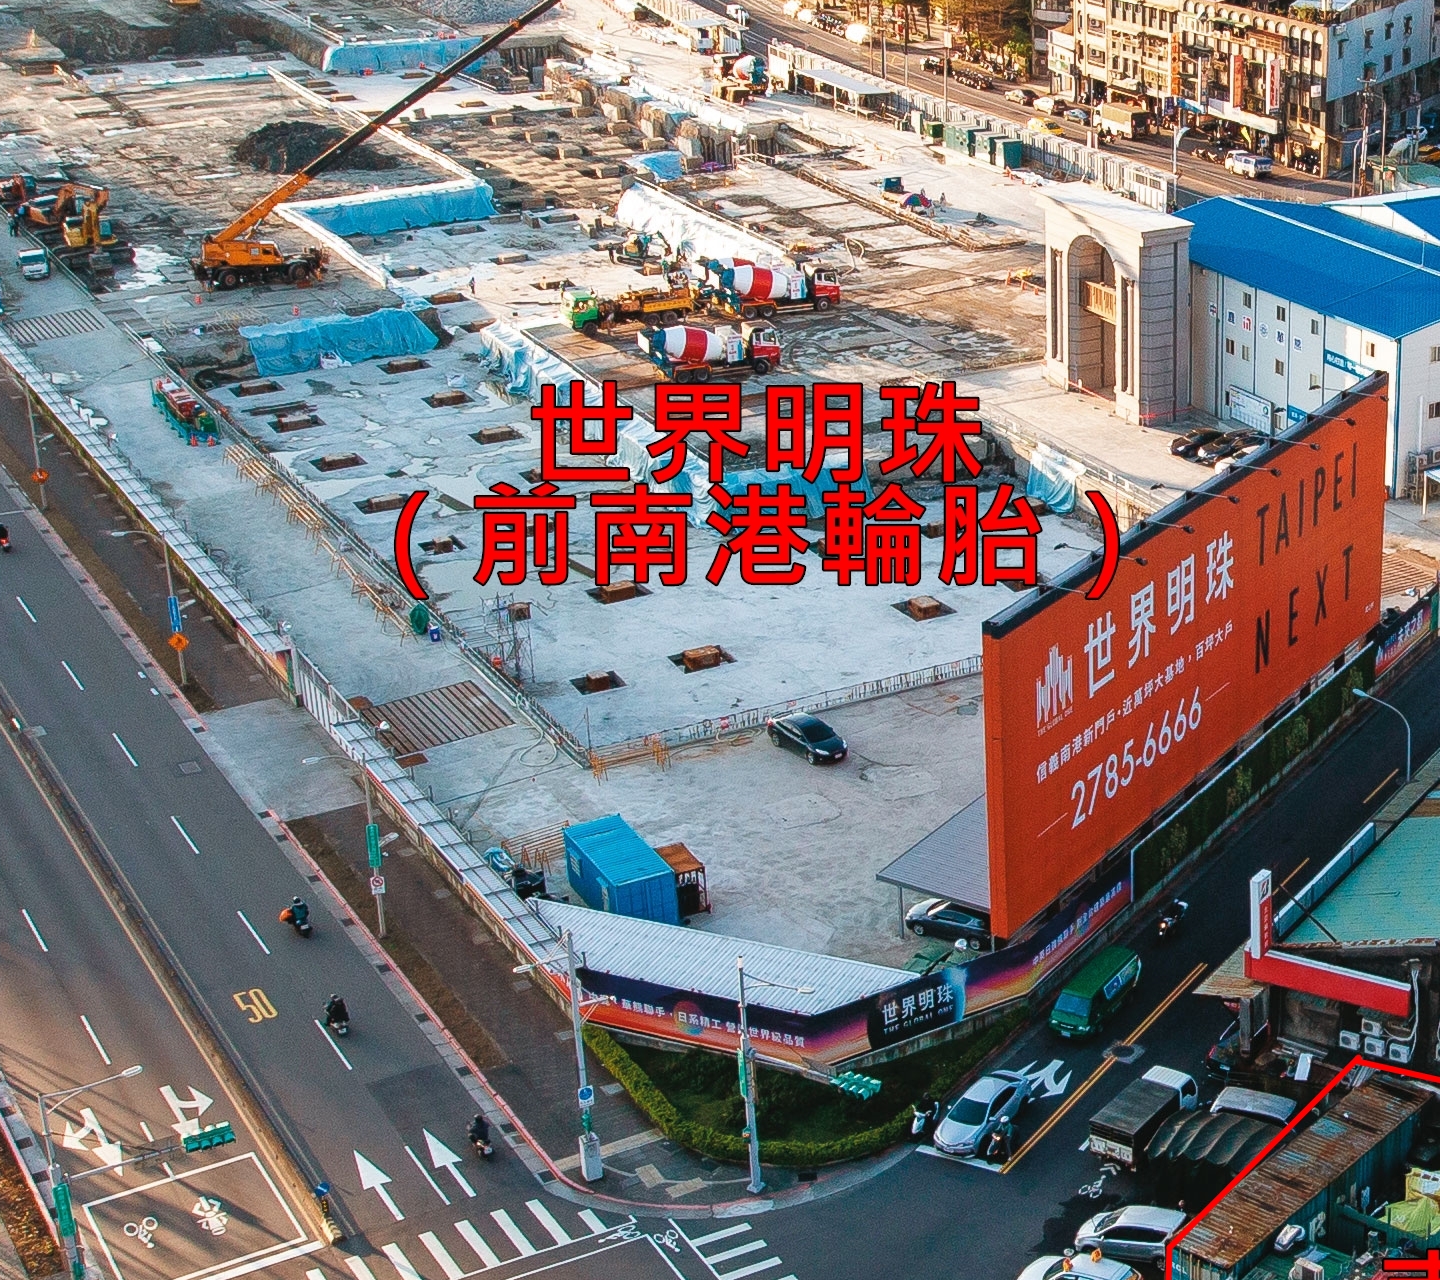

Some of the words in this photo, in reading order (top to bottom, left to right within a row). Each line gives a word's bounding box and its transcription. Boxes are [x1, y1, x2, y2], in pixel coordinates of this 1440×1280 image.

[1256, 441, 1358, 566] TAIPEI
[1084, 530, 1235, 699] 世界明珠
[1254, 544, 1354, 674] NEXT
[1071, 686, 1203, 830] 2785-6666
[232, 988, 279, 1024] 50
[881, 982, 955, 1026] 世界明珠
